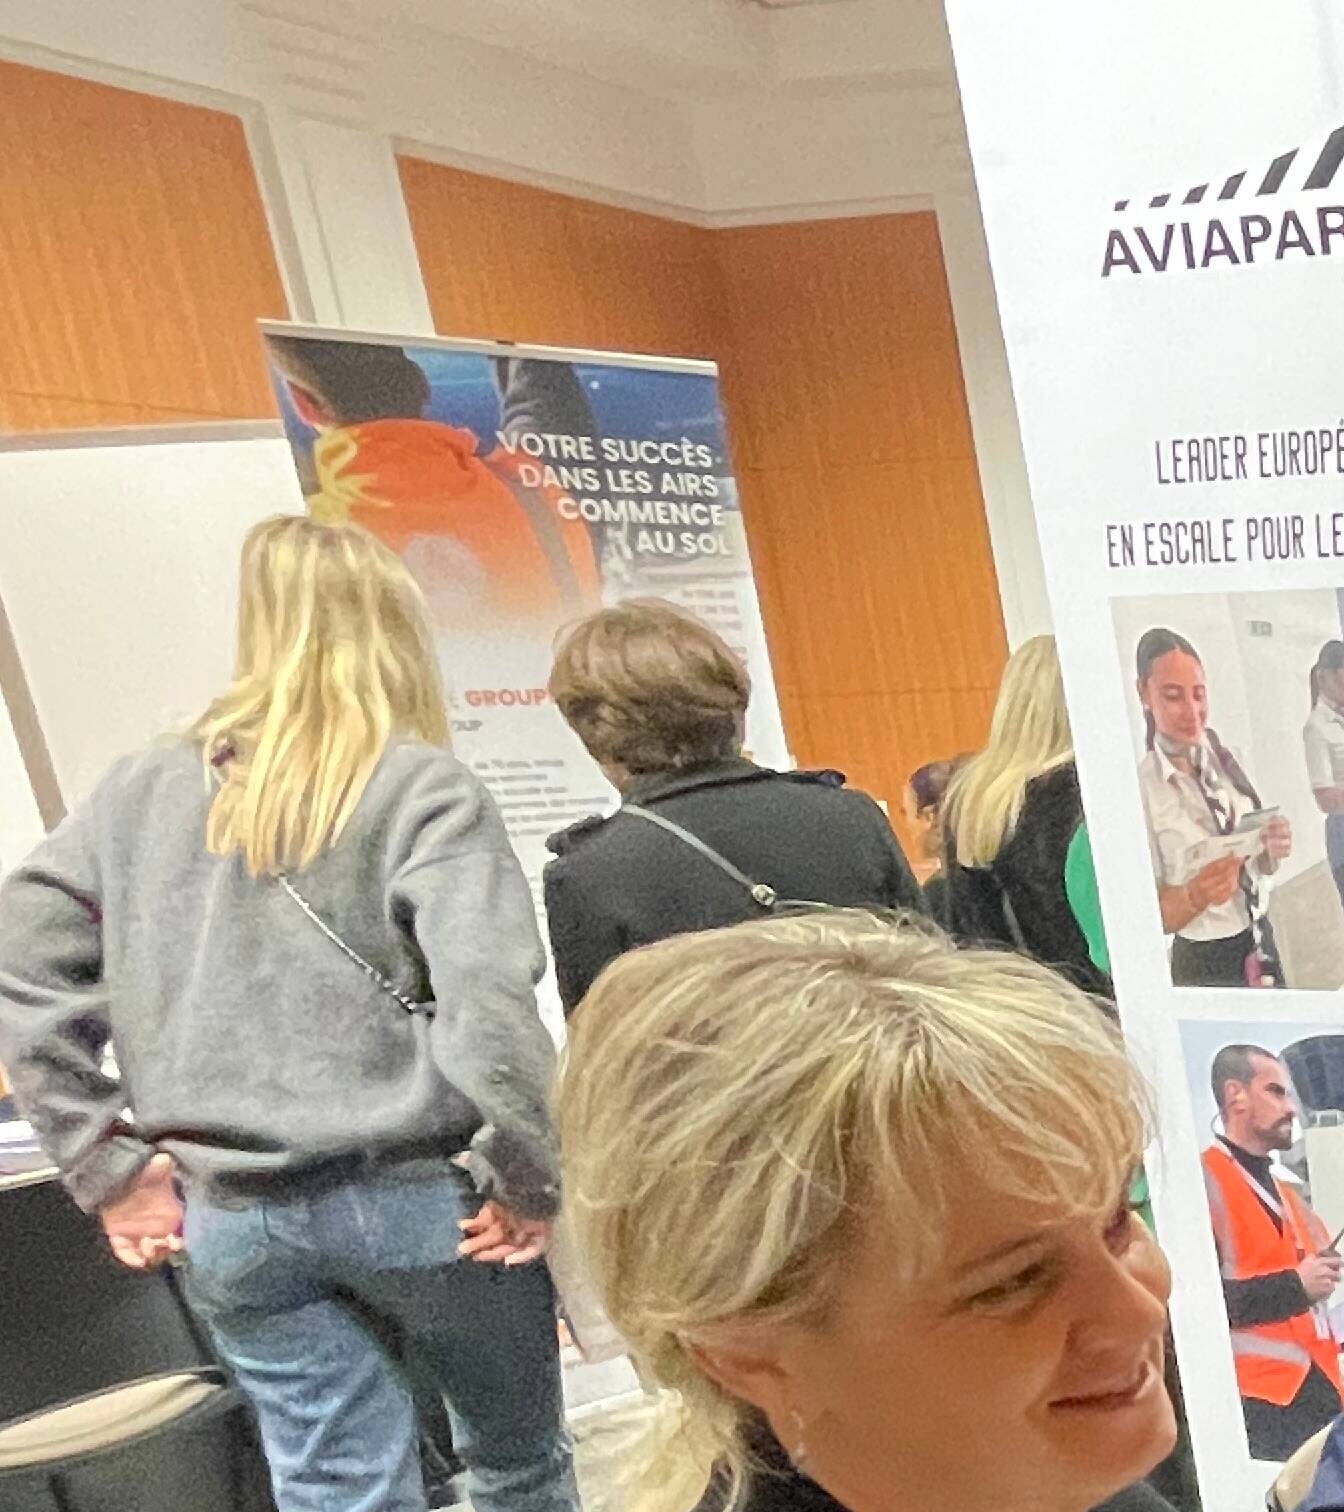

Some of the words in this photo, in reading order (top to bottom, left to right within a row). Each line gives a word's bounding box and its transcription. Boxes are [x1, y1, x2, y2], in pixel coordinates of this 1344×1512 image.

[496, 430, 597, 461] VOTRE
[600, 436, 713, 468] SUCCÈS
[1155, 435, 1248, 485] LEADER
[518, 464, 601, 492] DANS
[606, 468, 653, 494] LES
[660, 472, 719, 497] AIRS
[557, 497, 728, 526] COMMENCE
[636, 530, 675, 554] AU
[680, 532, 733, 556] SOL
[1106, 523, 1136, 568] EN
[1143, 518, 1238, 566] ESCALE
[1246, 514, 1306, 562] POUR
